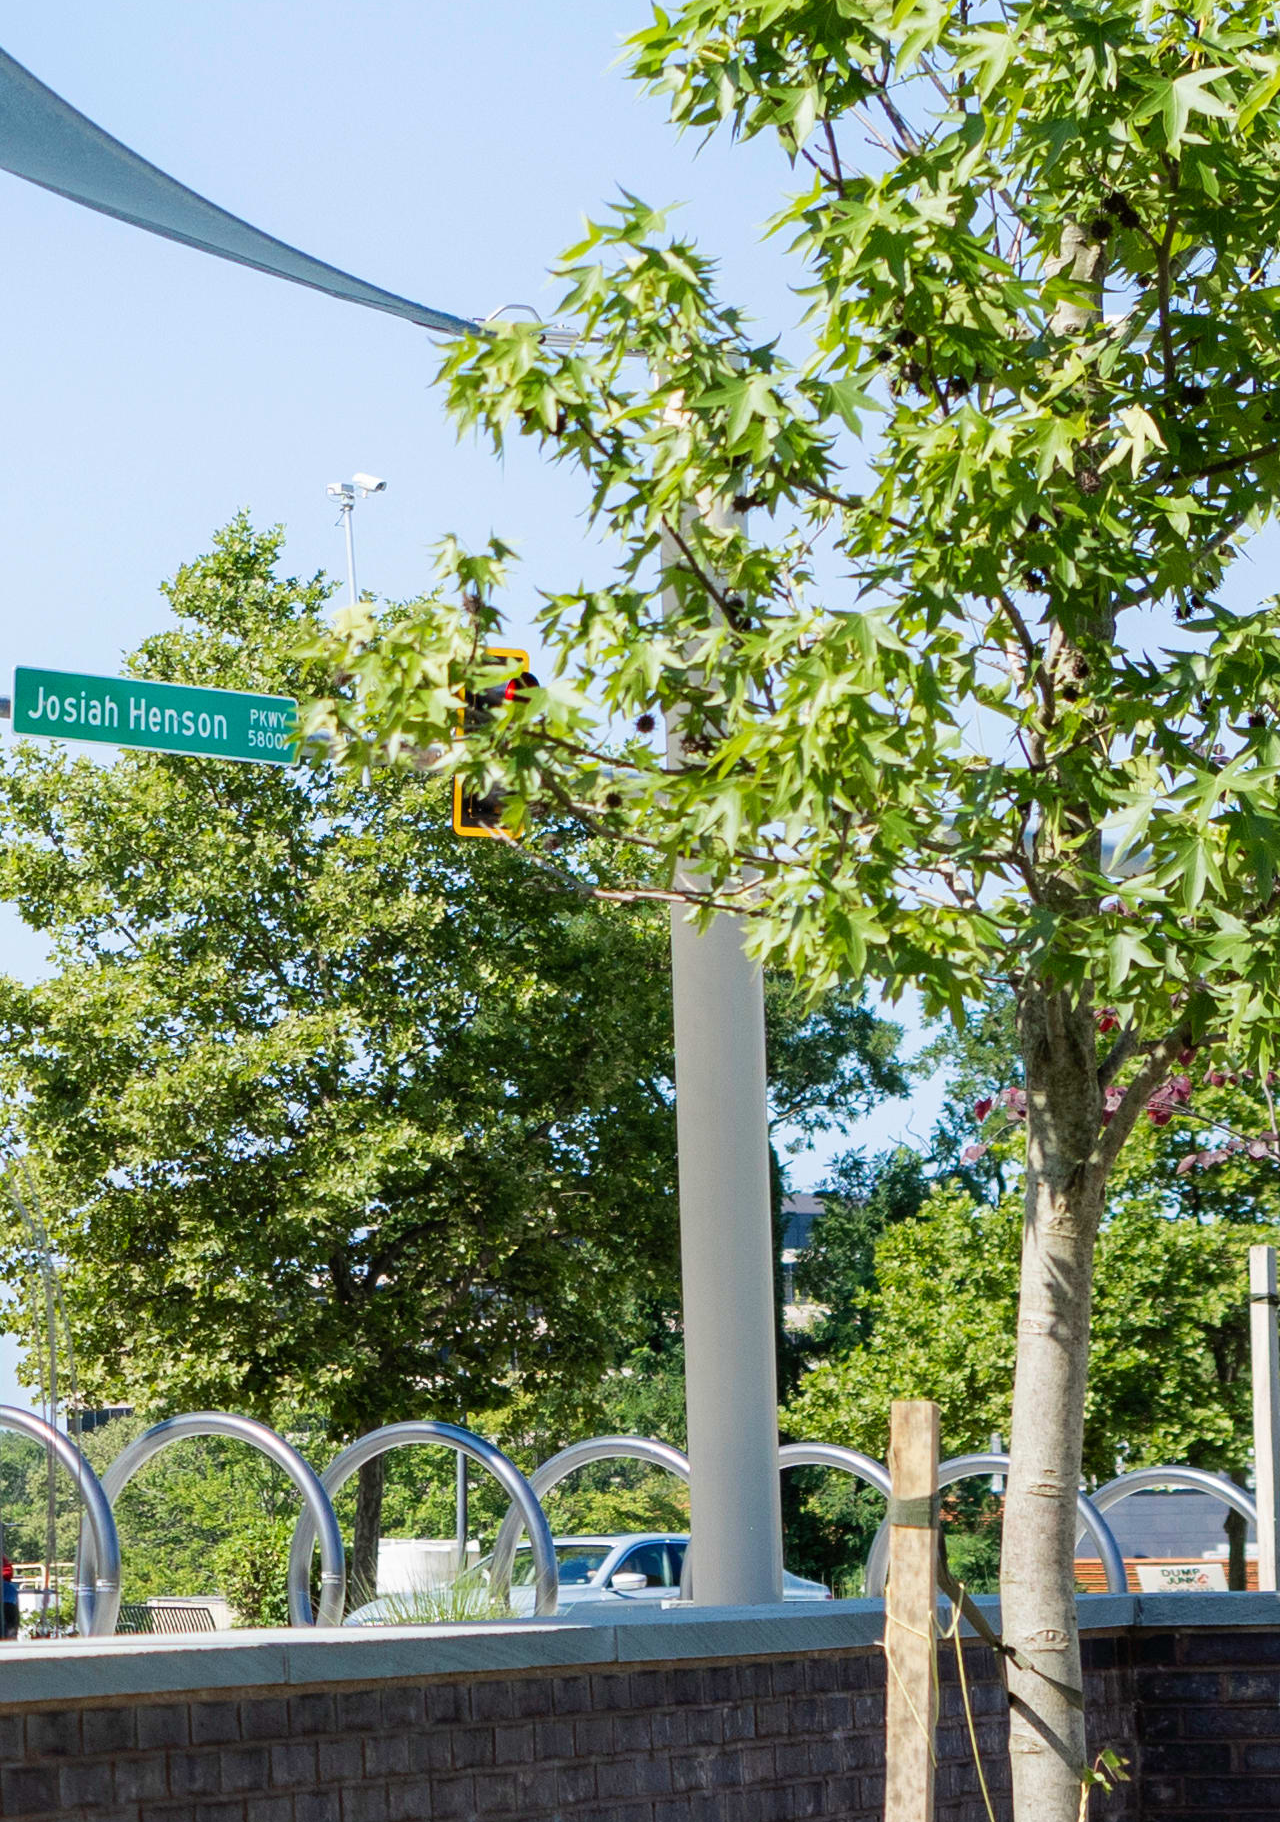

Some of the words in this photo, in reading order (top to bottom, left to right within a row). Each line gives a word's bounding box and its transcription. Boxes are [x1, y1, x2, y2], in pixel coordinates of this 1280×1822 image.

[28, 687, 118, 728] Josiah
[129, 697, 228, 740] Henson
[250, 708, 288, 729] PKWY
